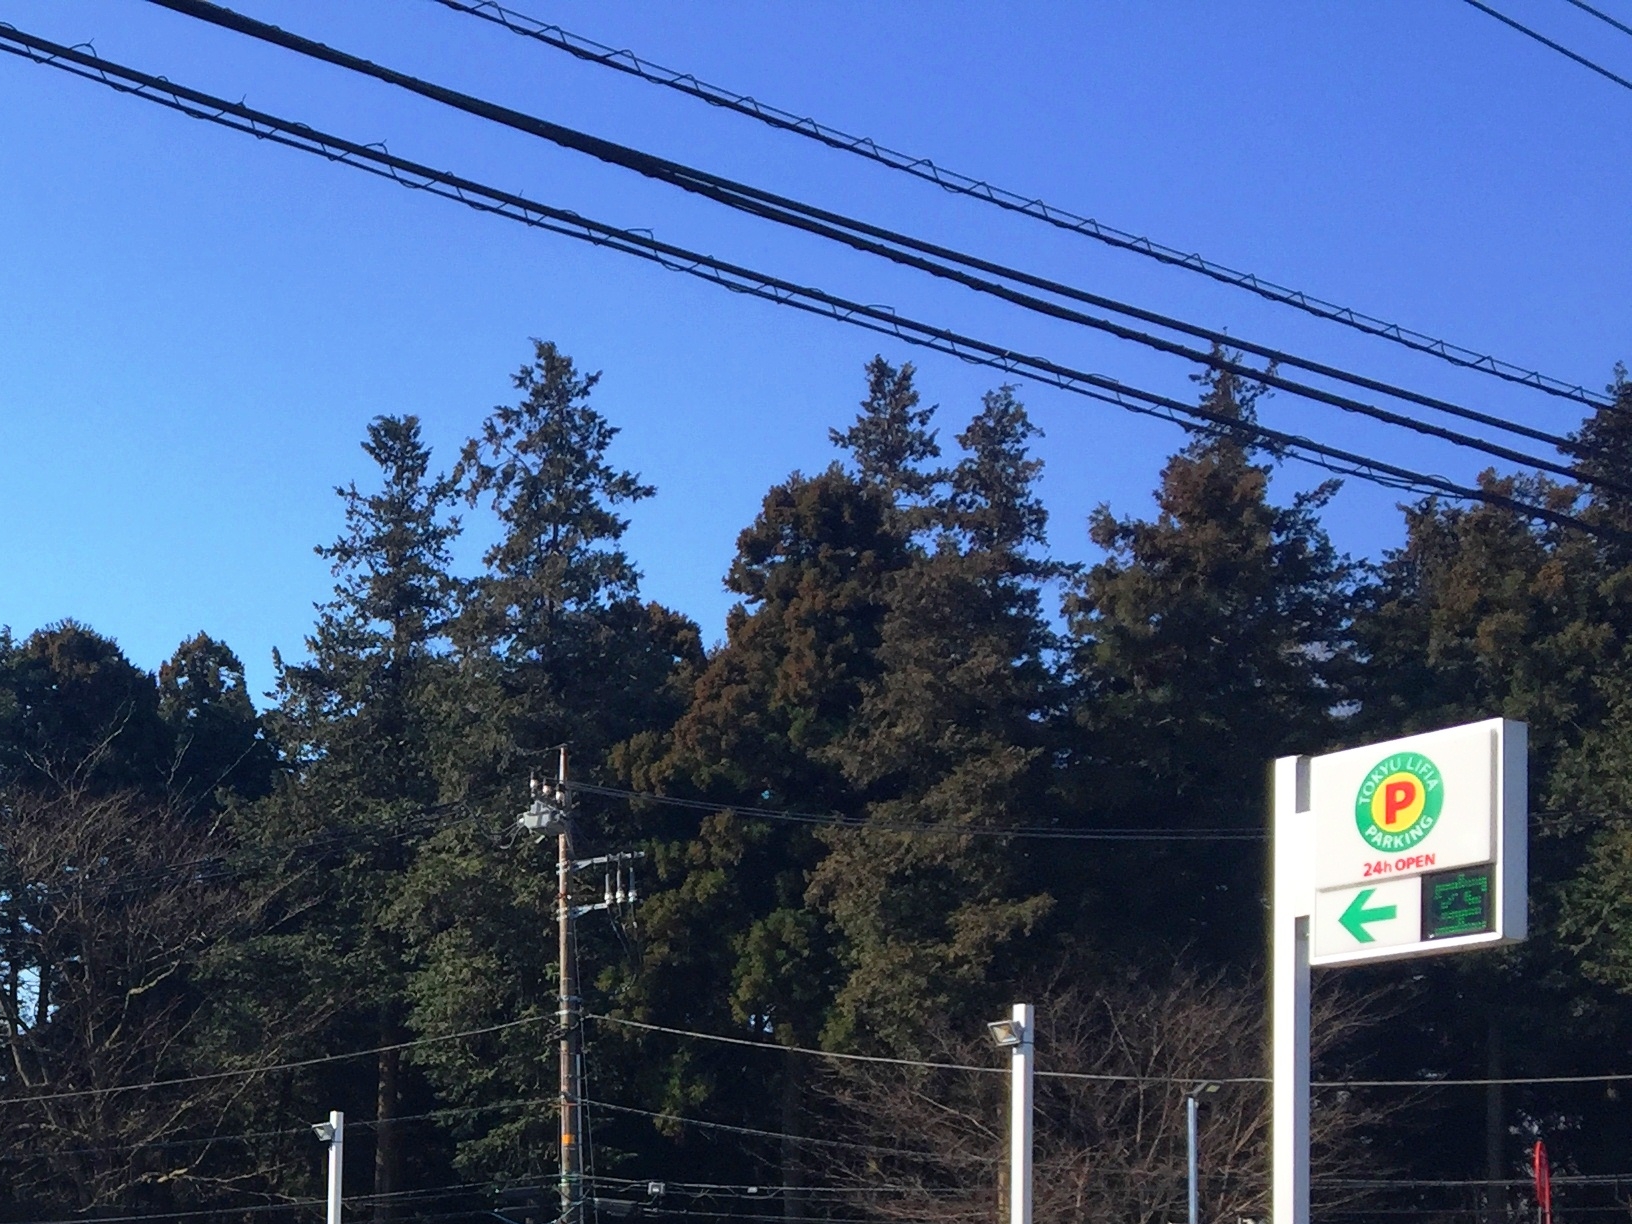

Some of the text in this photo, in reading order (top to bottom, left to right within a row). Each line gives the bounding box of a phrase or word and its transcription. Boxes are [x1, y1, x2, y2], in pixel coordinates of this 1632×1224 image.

[1359, 756, 1440, 805] TOKYU LIFIA
[1385, 780, 1417, 825] P
[1364, 814, 1434, 849] PARKING
[1363, 853, 1437, 877] 24h OPEN
